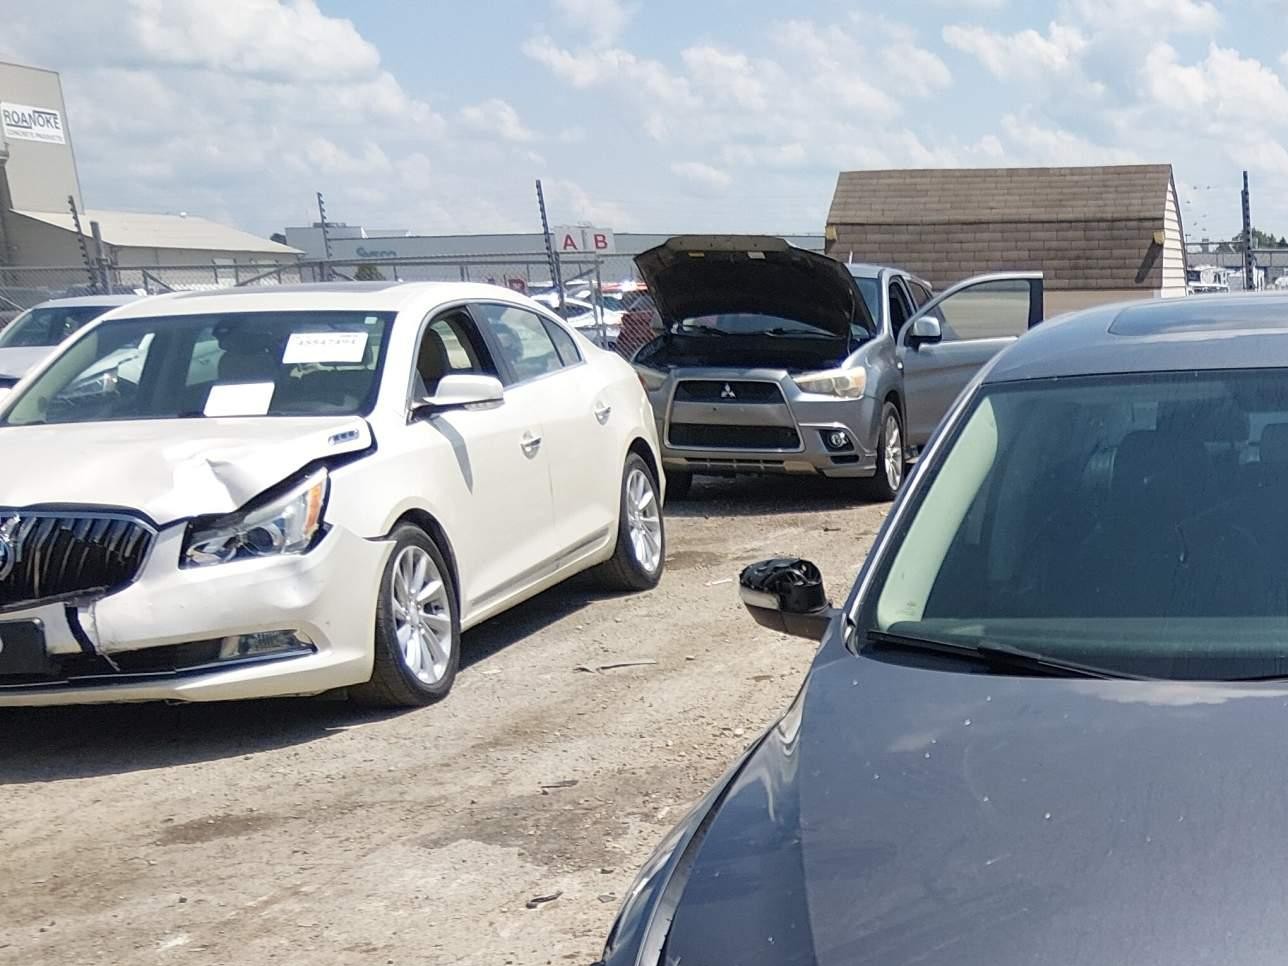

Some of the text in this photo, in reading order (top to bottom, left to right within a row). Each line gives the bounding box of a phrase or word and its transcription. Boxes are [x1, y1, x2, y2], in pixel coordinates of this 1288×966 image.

[3, 109, 61, 130] ROANOKE
[563, 233, 578, 250] A
[593, 233, 608, 249] B
